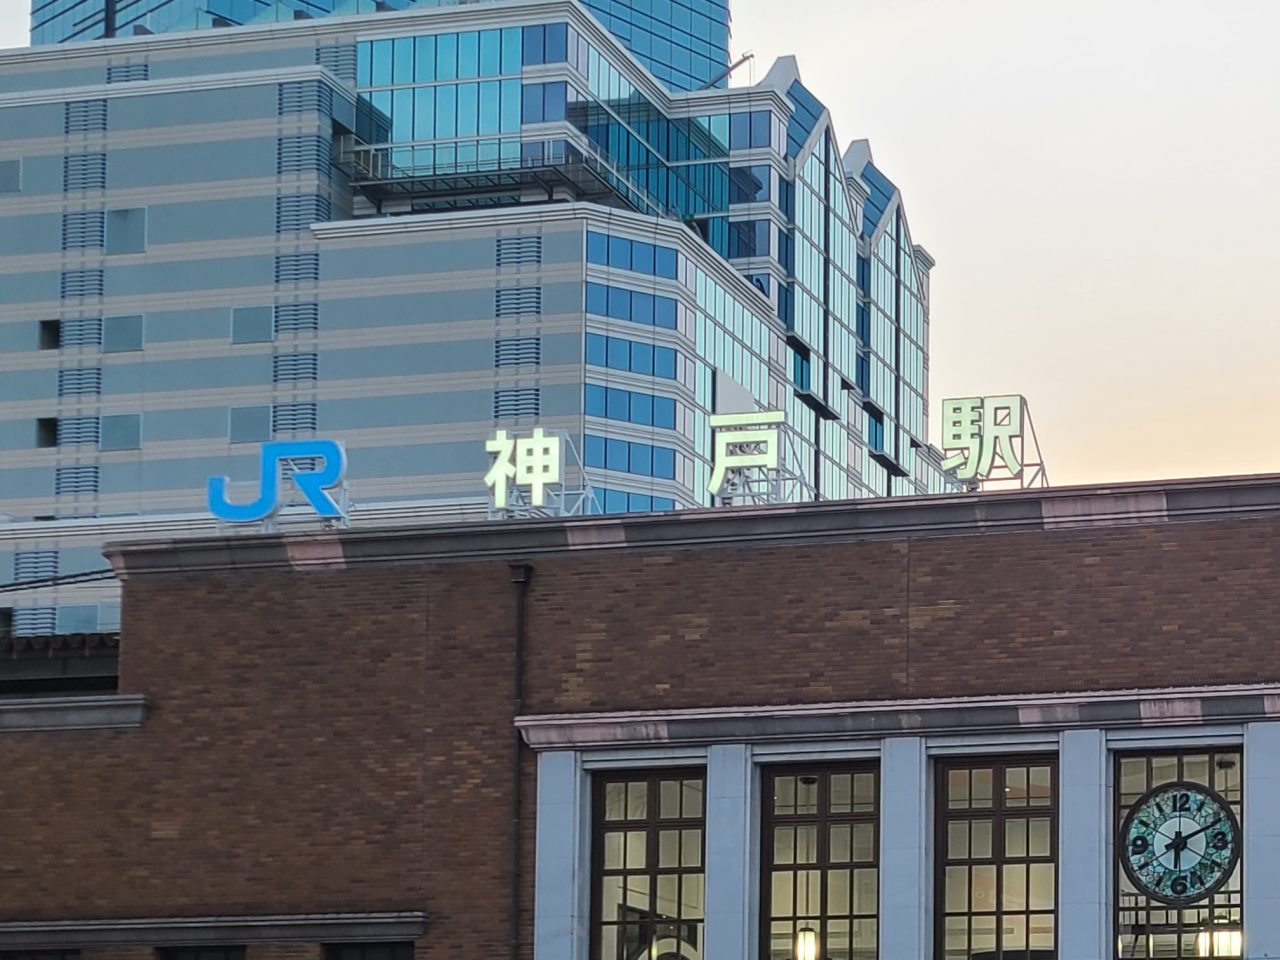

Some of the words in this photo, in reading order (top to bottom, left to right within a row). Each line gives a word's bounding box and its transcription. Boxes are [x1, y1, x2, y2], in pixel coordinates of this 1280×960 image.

[208, 440, 345, 522] JR
[1171, 793, 1191, 812] 12
[1131, 835, 1148, 854] 9
[1212, 831, 1228, 850] 3
[1170, 876, 1188, 895] 6
